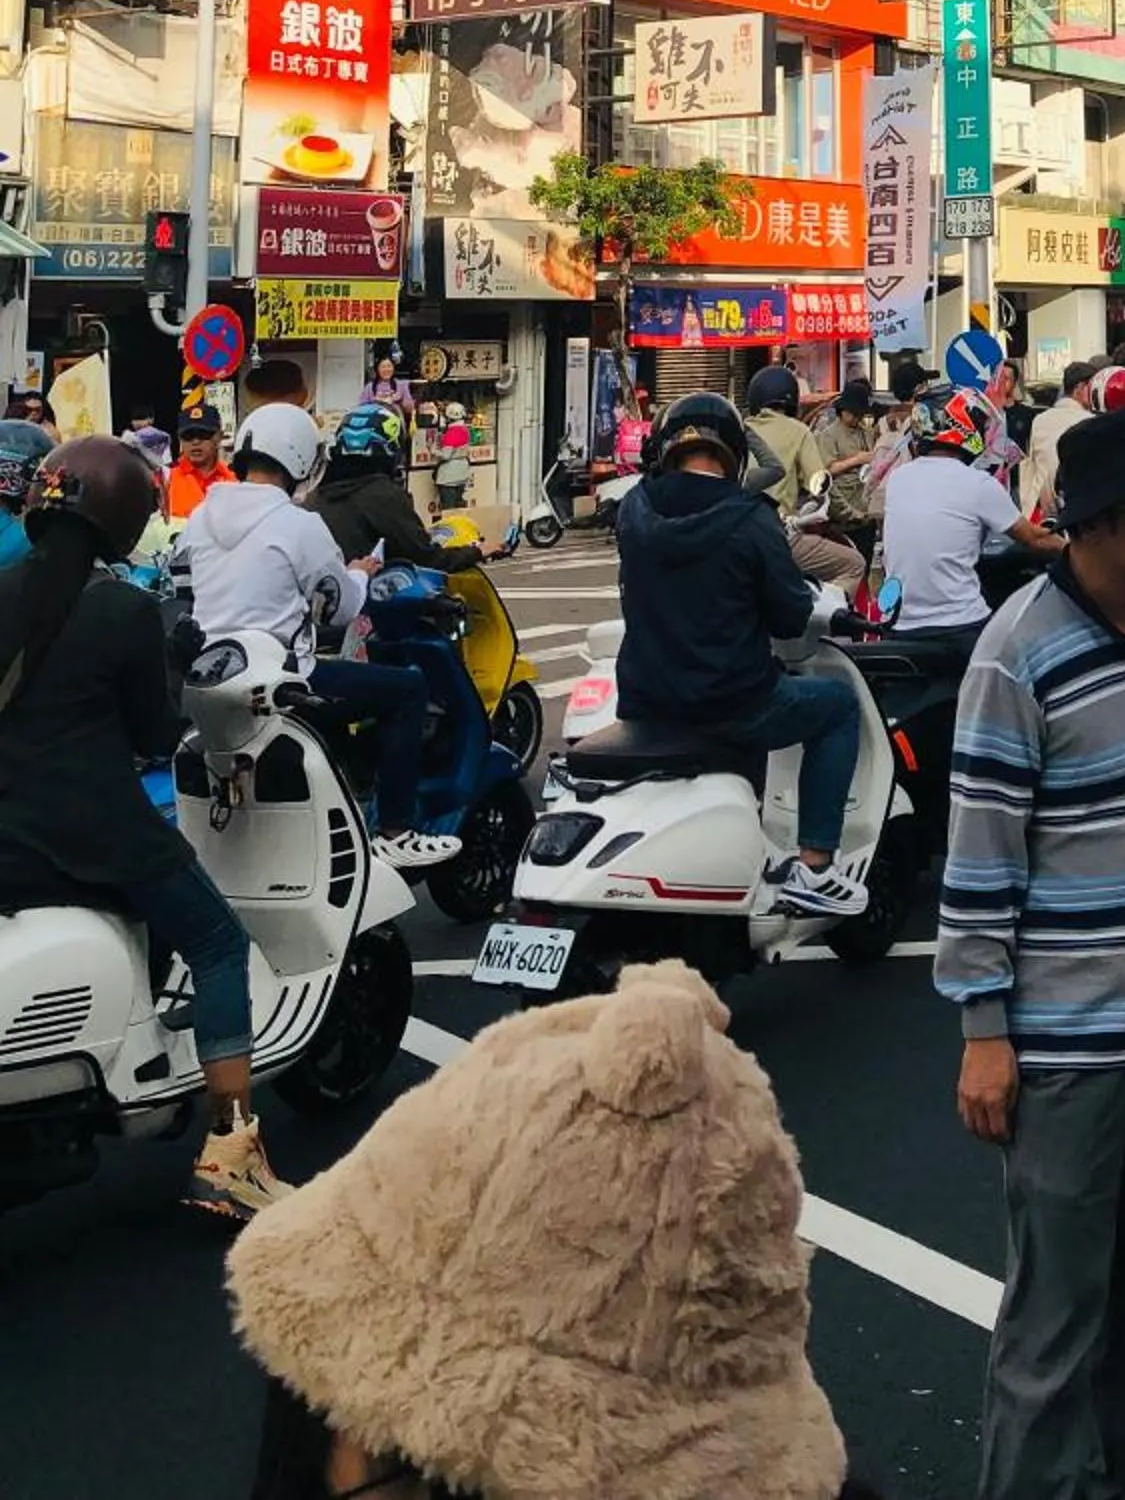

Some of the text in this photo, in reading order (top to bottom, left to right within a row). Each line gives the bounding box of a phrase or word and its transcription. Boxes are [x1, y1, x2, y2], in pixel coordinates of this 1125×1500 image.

[280, 0, 363, 54] 銀波
[954, 1, 976, 26] 東
[956, 65, 979, 191] 中正路
[281, 227, 327, 257] 銀波
[767, 199, 850, 248] 康是美
[1027, 228, 1089, 265] 阿瘦皮鞋
